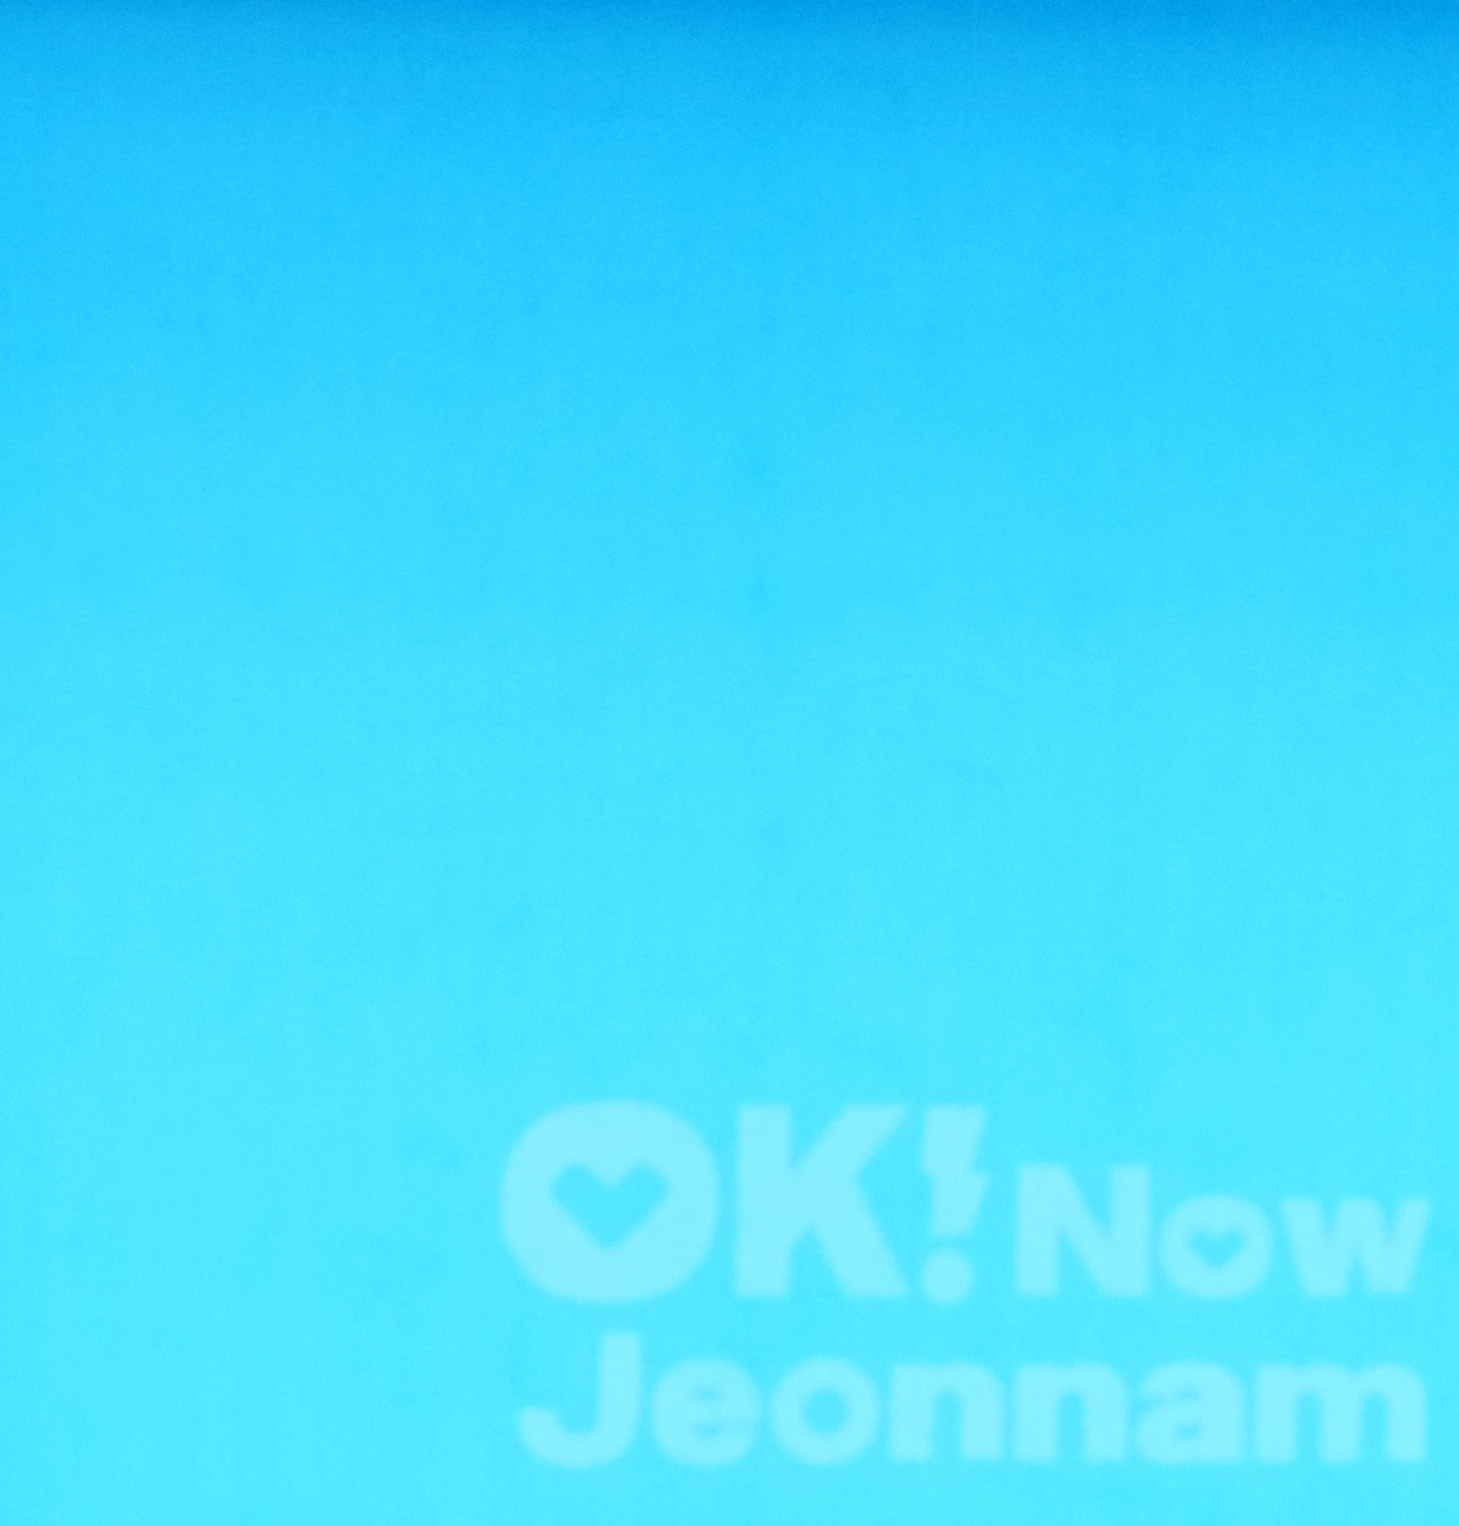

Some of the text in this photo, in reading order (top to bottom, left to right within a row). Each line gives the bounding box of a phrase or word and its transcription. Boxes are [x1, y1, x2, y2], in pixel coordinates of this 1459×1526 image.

[499, 1098, 1431, 1305] OK! Now
[518, 1330, 1430, 1468] Jeonnam
